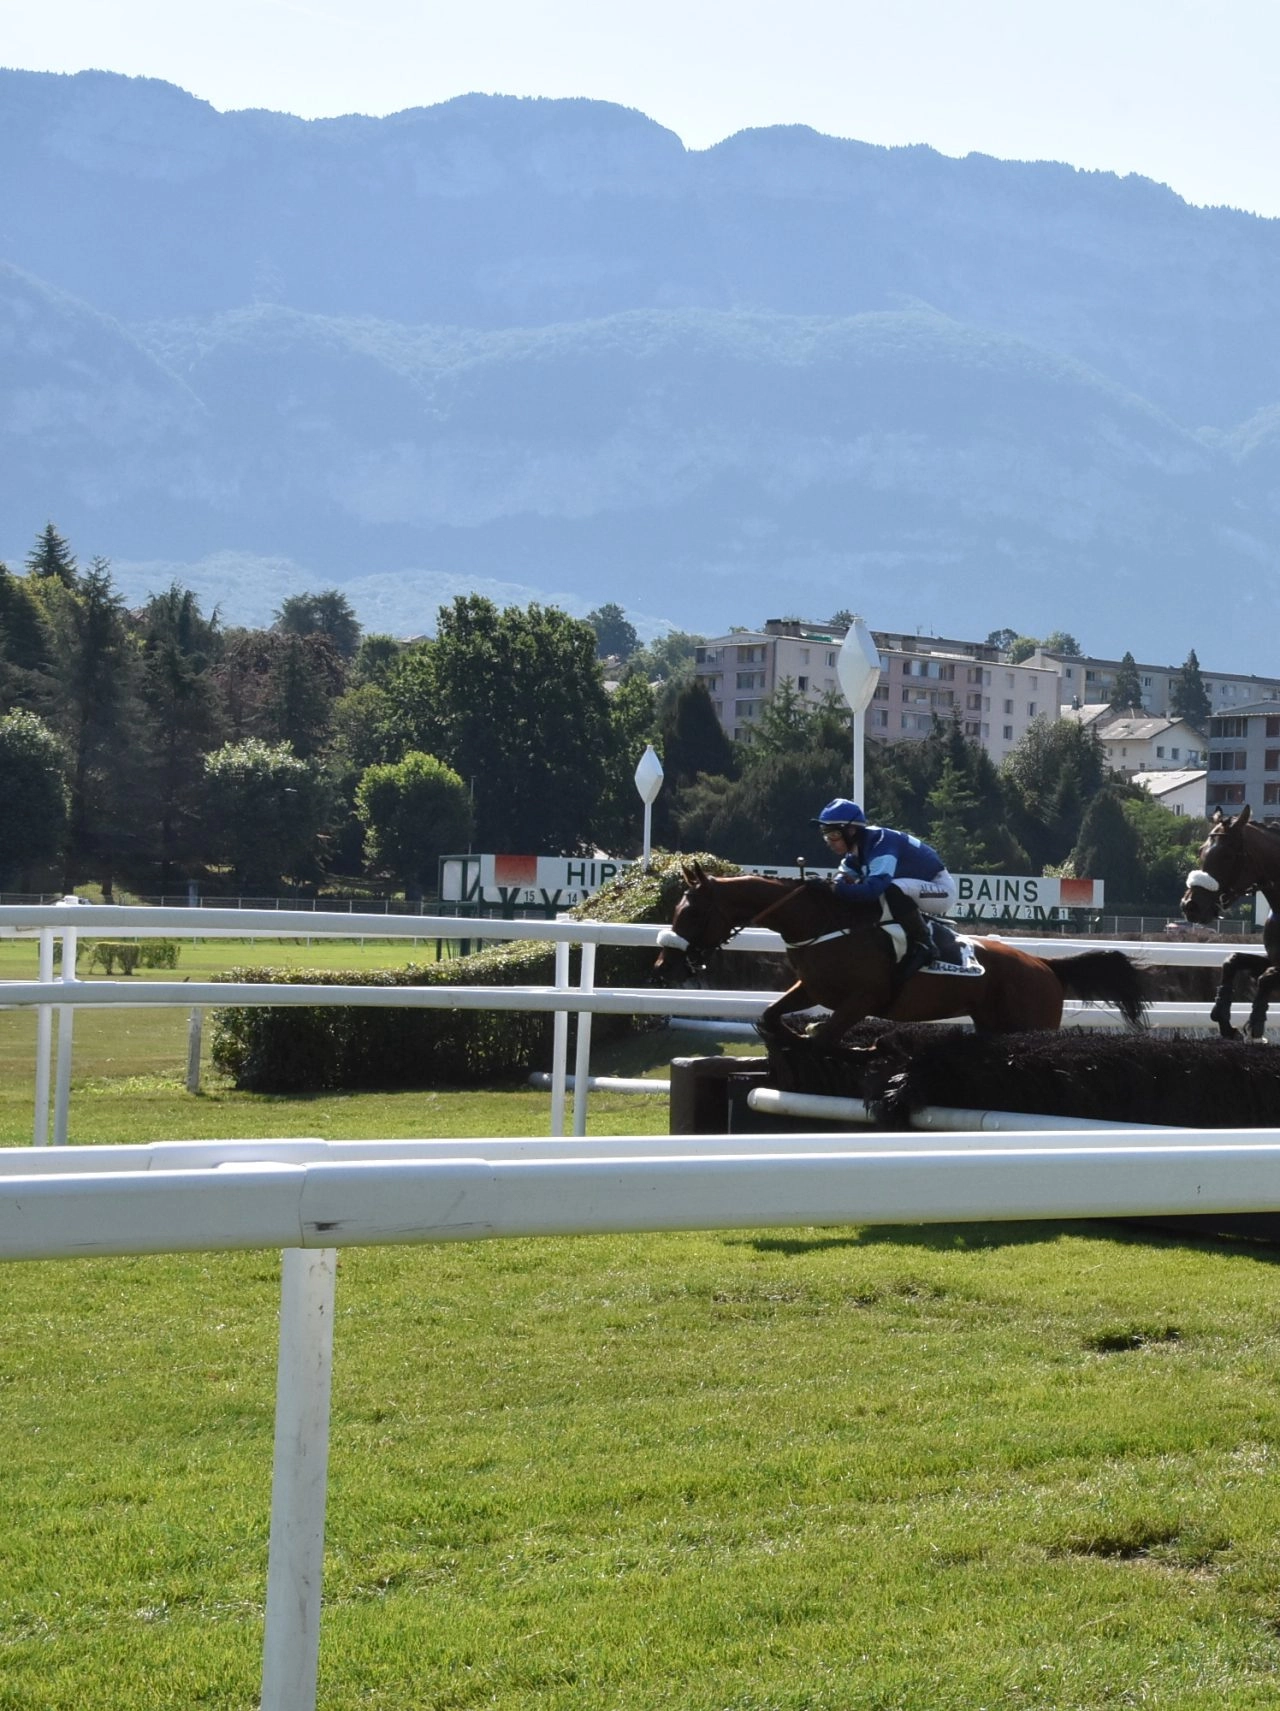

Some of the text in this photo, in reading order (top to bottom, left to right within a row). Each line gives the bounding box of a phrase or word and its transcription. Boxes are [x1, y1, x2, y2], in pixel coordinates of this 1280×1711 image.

[958, 878, 1038, 902] BAINS
[524, 890, 535, 902] 15
[567, 893, 577, 904] 14
[992, 905, 998, 917] 3
[1026, 907, 1033, 918] 2
